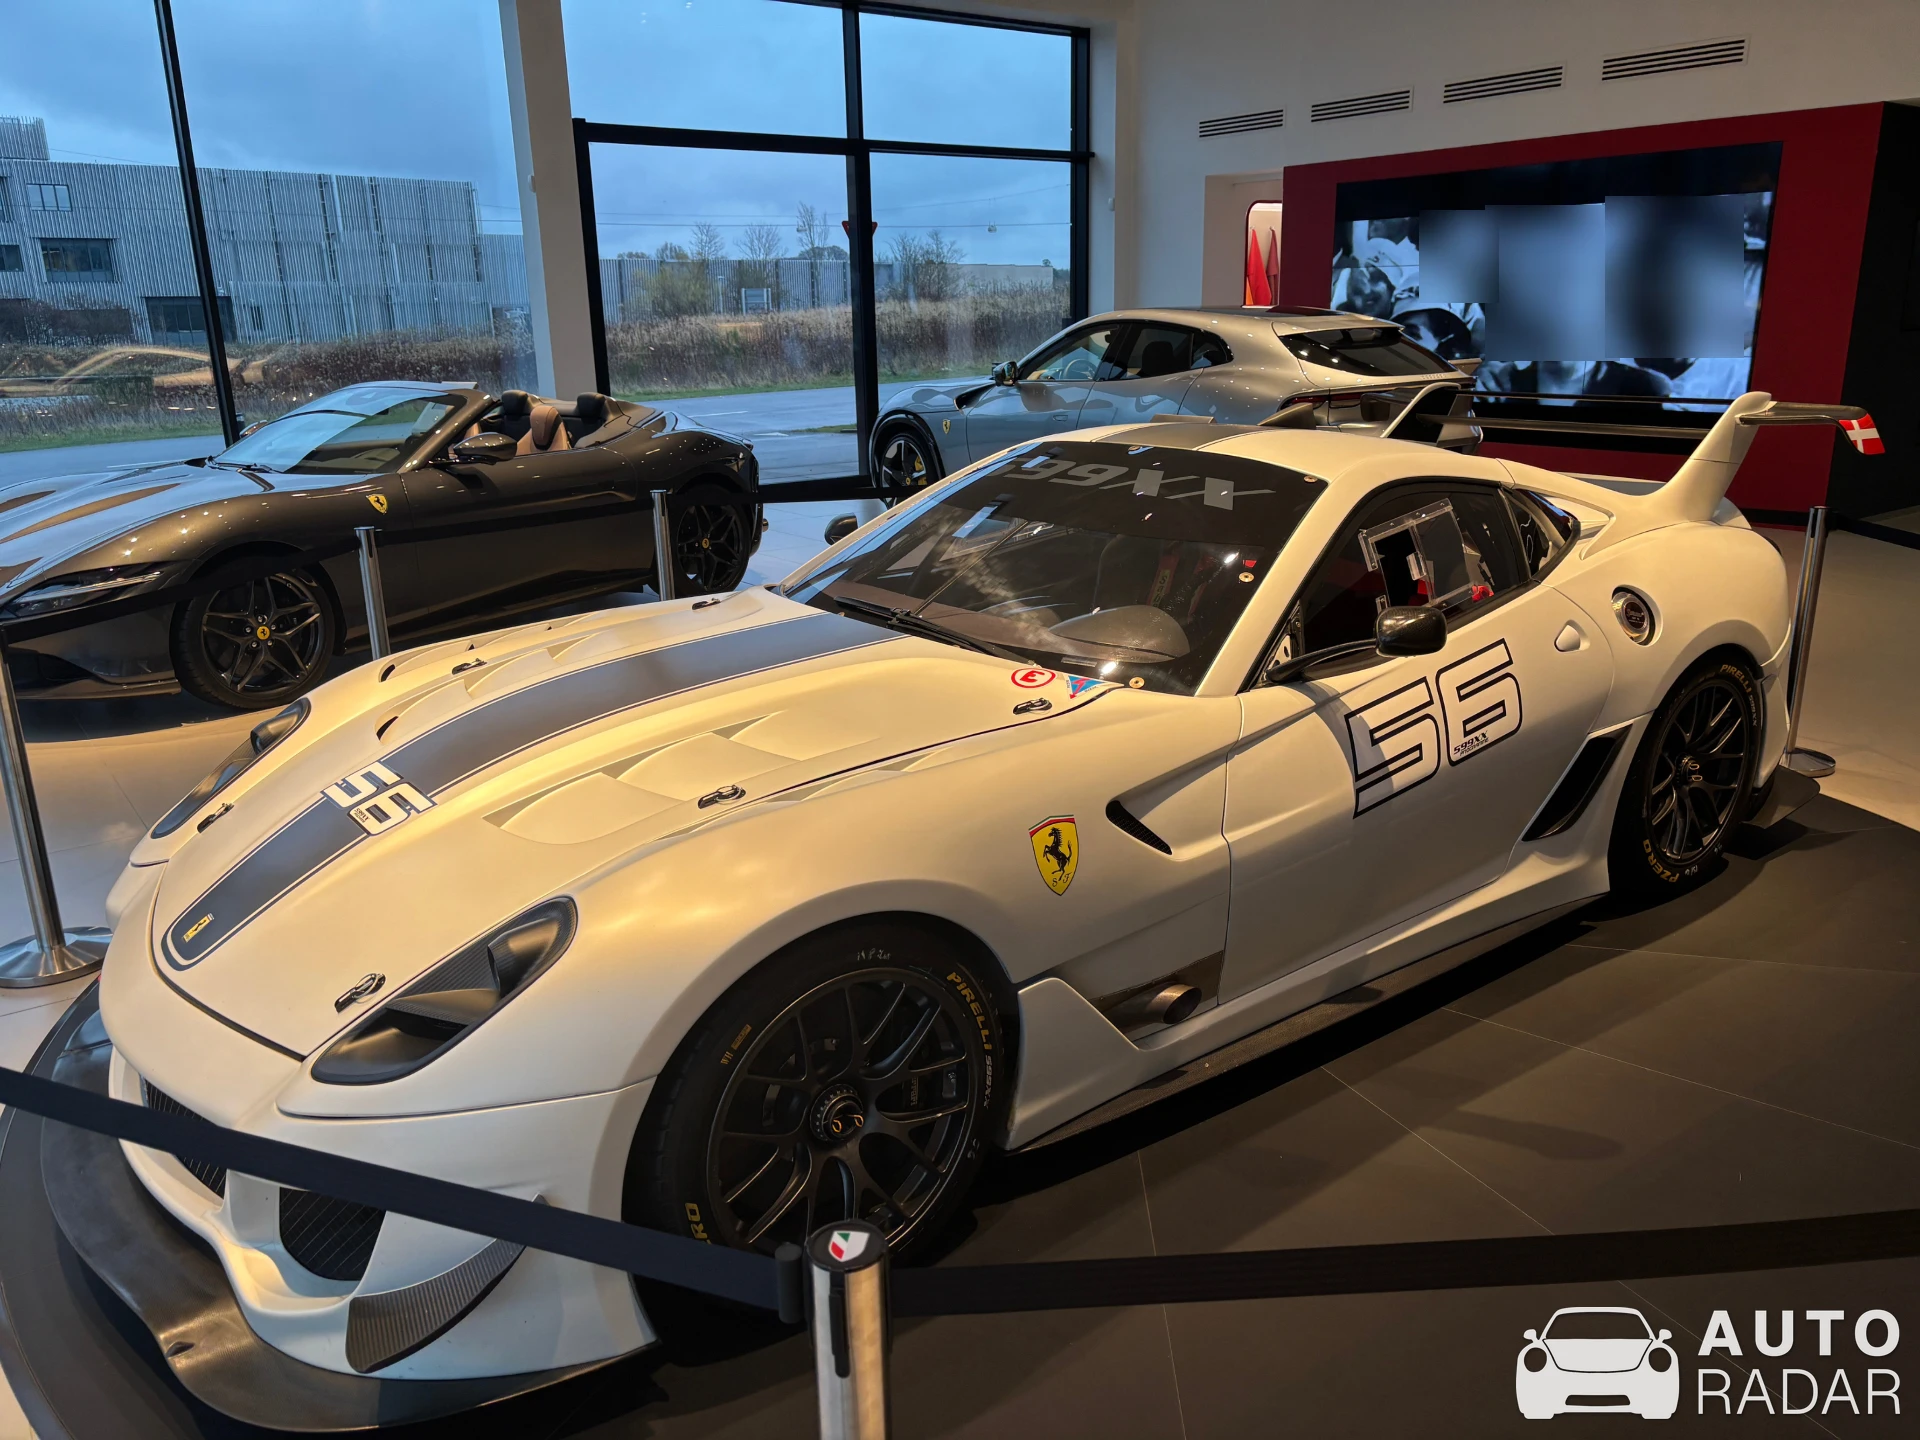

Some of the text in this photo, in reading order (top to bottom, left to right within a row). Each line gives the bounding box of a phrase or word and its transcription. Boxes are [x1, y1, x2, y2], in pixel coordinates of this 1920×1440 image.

[1720, 664, 1752, 693] PIRELLI
[1343, 637, 1523, 820] 56
[1453, 730, 1488, 755] 599XX
[320, 760, 438, 836] 56
[946, 971, 993, 1050] PIRELLI
[983, 1054, 993, 1110] 599XX
